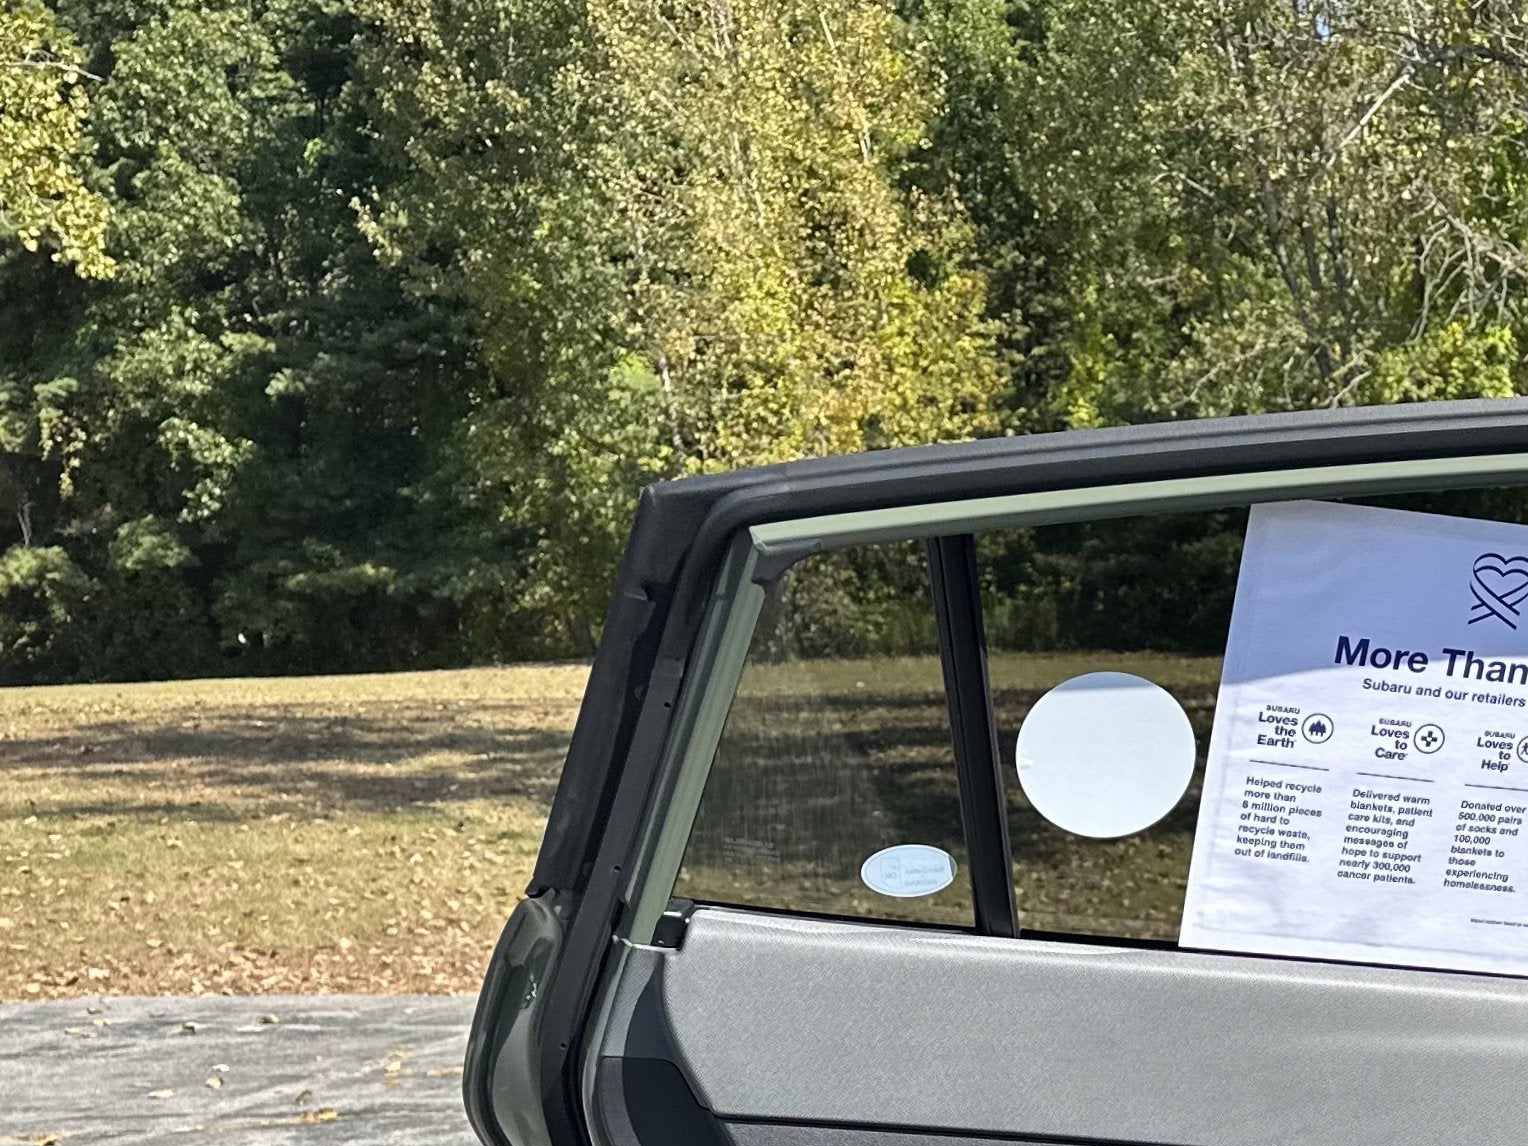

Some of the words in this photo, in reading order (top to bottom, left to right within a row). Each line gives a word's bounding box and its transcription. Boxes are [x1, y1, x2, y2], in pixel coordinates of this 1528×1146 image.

[1334, 635, 1429, 674] More
[1441, 647, 1528, 685] Than
[1362, 678, 1412, 696] Subaru
[1415, 686, 1442, 698] and
[1445, 690, 1469, 703] our
[1471, 692, 1526, 708] retailers
[1258, 711, 1298, 726] Loves
[1274, 725, 1296, 737] the
[1371, 725, 1409, 739] Loves
[1257, 734, 1295, 748] Earth
[1395, 740, 1407, 750] to
[1477, 737, 1513, 750] Loves
[1375, 747, 1406, 760] Care
[1499, 751, 1511, 760] to
[1481, 759, 1509, 773] Help
[1246, 777, 1283, 788] Helped
[1285, 783, 1322, 793] recycle
[1244, 790, 1270, 799] more
[1274, 792, 1296, 802] than
[1352, 789, 1400, 801] Delivered
[1403, 795, 1430, 805] warm
[1251, 802, 1285, 813] million
[1288, 806, 1322, 817] pieces
[1398, 806, 1433, 817] patient
[1461, 800, 1502, 811] Donated
[1505, 805, 1527, 813] over
[1253, 813, 1277, 823] hard
[1280, 816, 1289, 825] to
[1348, 813, 1370, 821] care
[1396, 818, 1415, 827] and
[1497, 815, 1523, 825] pairs
[1239, 825, 1274, 835] recycle
[1345, 825, 1408, 839] encouraging
[1468, 825, 1497, 834] socks
[1499, 828, 1518, 836] and
[1237, 835, 1277, 849] keeping
[1280, 840, 1305, 850] them
[1344, 836, 1394, 848] messages
[1397, 841, 1408, 849] of
[1235, 848, 1251, 856] out
[1341, 846, 1367, 857] hope
[1369, 849, 1379, 858] to
[1382, 851, 1421, 862] support
[1450, 845, 1492, 856] blankets
[1495, 850, 1505, 858] to
[1339, 859, 1370, 870] nearly
[1448, 856, 1476, 866] those
[1337, 870, 1371, 879] cancer
[1446, 869, 1508, 883] experiencing
